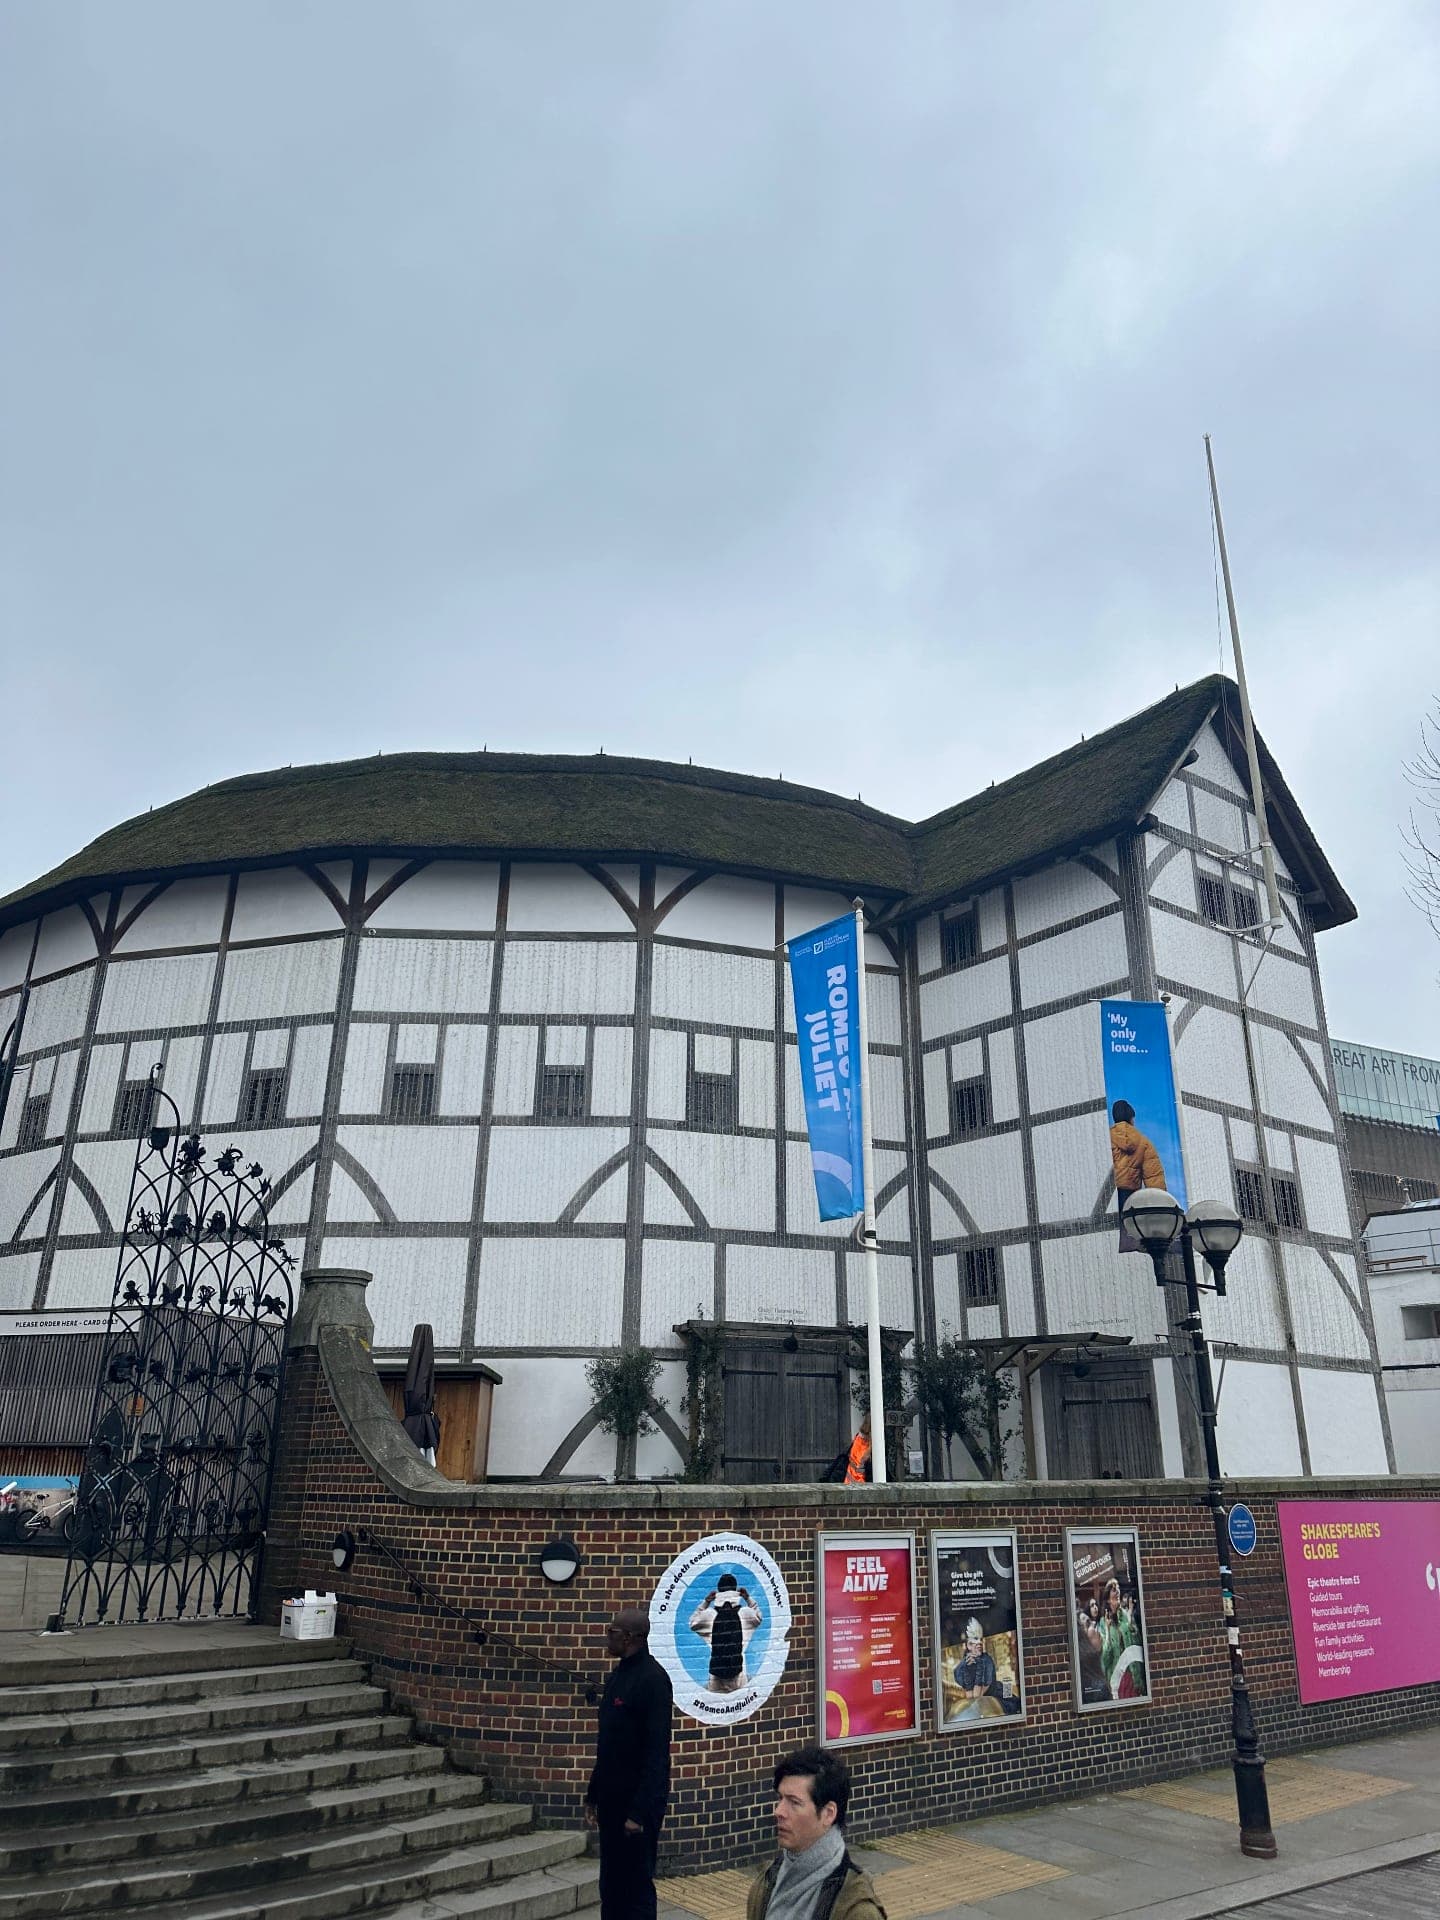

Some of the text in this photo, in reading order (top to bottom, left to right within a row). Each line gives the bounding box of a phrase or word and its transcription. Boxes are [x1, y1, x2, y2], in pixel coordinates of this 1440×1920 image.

[1111, 1028, 1136, 1042] only
[1111, 1041, 1148, 1054] love...
[804, 1010, 840, 1112] JULIET
[1333, 1048, 1366, 1070] REAT
[1372, 1056, 1396, 1077] ART
[1301, 1522, 1380, 1540] SHAKESPEARE'S
[1303, 1542, 1340, 1560] GLOBE
[846, 1556, 886, 1574] FEEL
[1074, 1554, 1091, 1570] GROUP
[1076, 1561, 1096, 1578] GUIDED
[1095, 1553, 1112, 1568] TOURS
[664, 1582, 676, 1600] she
[674, 1562, 690, 1583] doth
[690, 1548, 711, 1565] teach
[712, 1544, 724, 1553] the
[726, 1544, 752, 1556] torches
[752, 1553, 759, 1562] to
[759, 1558, 772, 1578] burn
[974, 1570, 983, 1580] gift
[842, 1574, 888, 1592] ALIVE
[1307, 1577, 1320, 1590] Epic
[1320, 1576, 1340, 1586] theatre
[1340, 1576, 1353, 1585] from
[1310, 1592, 1342, 1602] Guided tours
[1311, 1604, 1369, 1616] Memorabilia and gifting
[1313, 1617, 1381, 1632] Riverside bar and restaurant
[1315, 1634, 1365, 1647] Fun family activities
[1317, 1647, 1374, 1662] World-leading research
[1319, 1664, 1351, 1677] Membership
[692, 1692, 758, 1714] #RomeoAndJuliet
